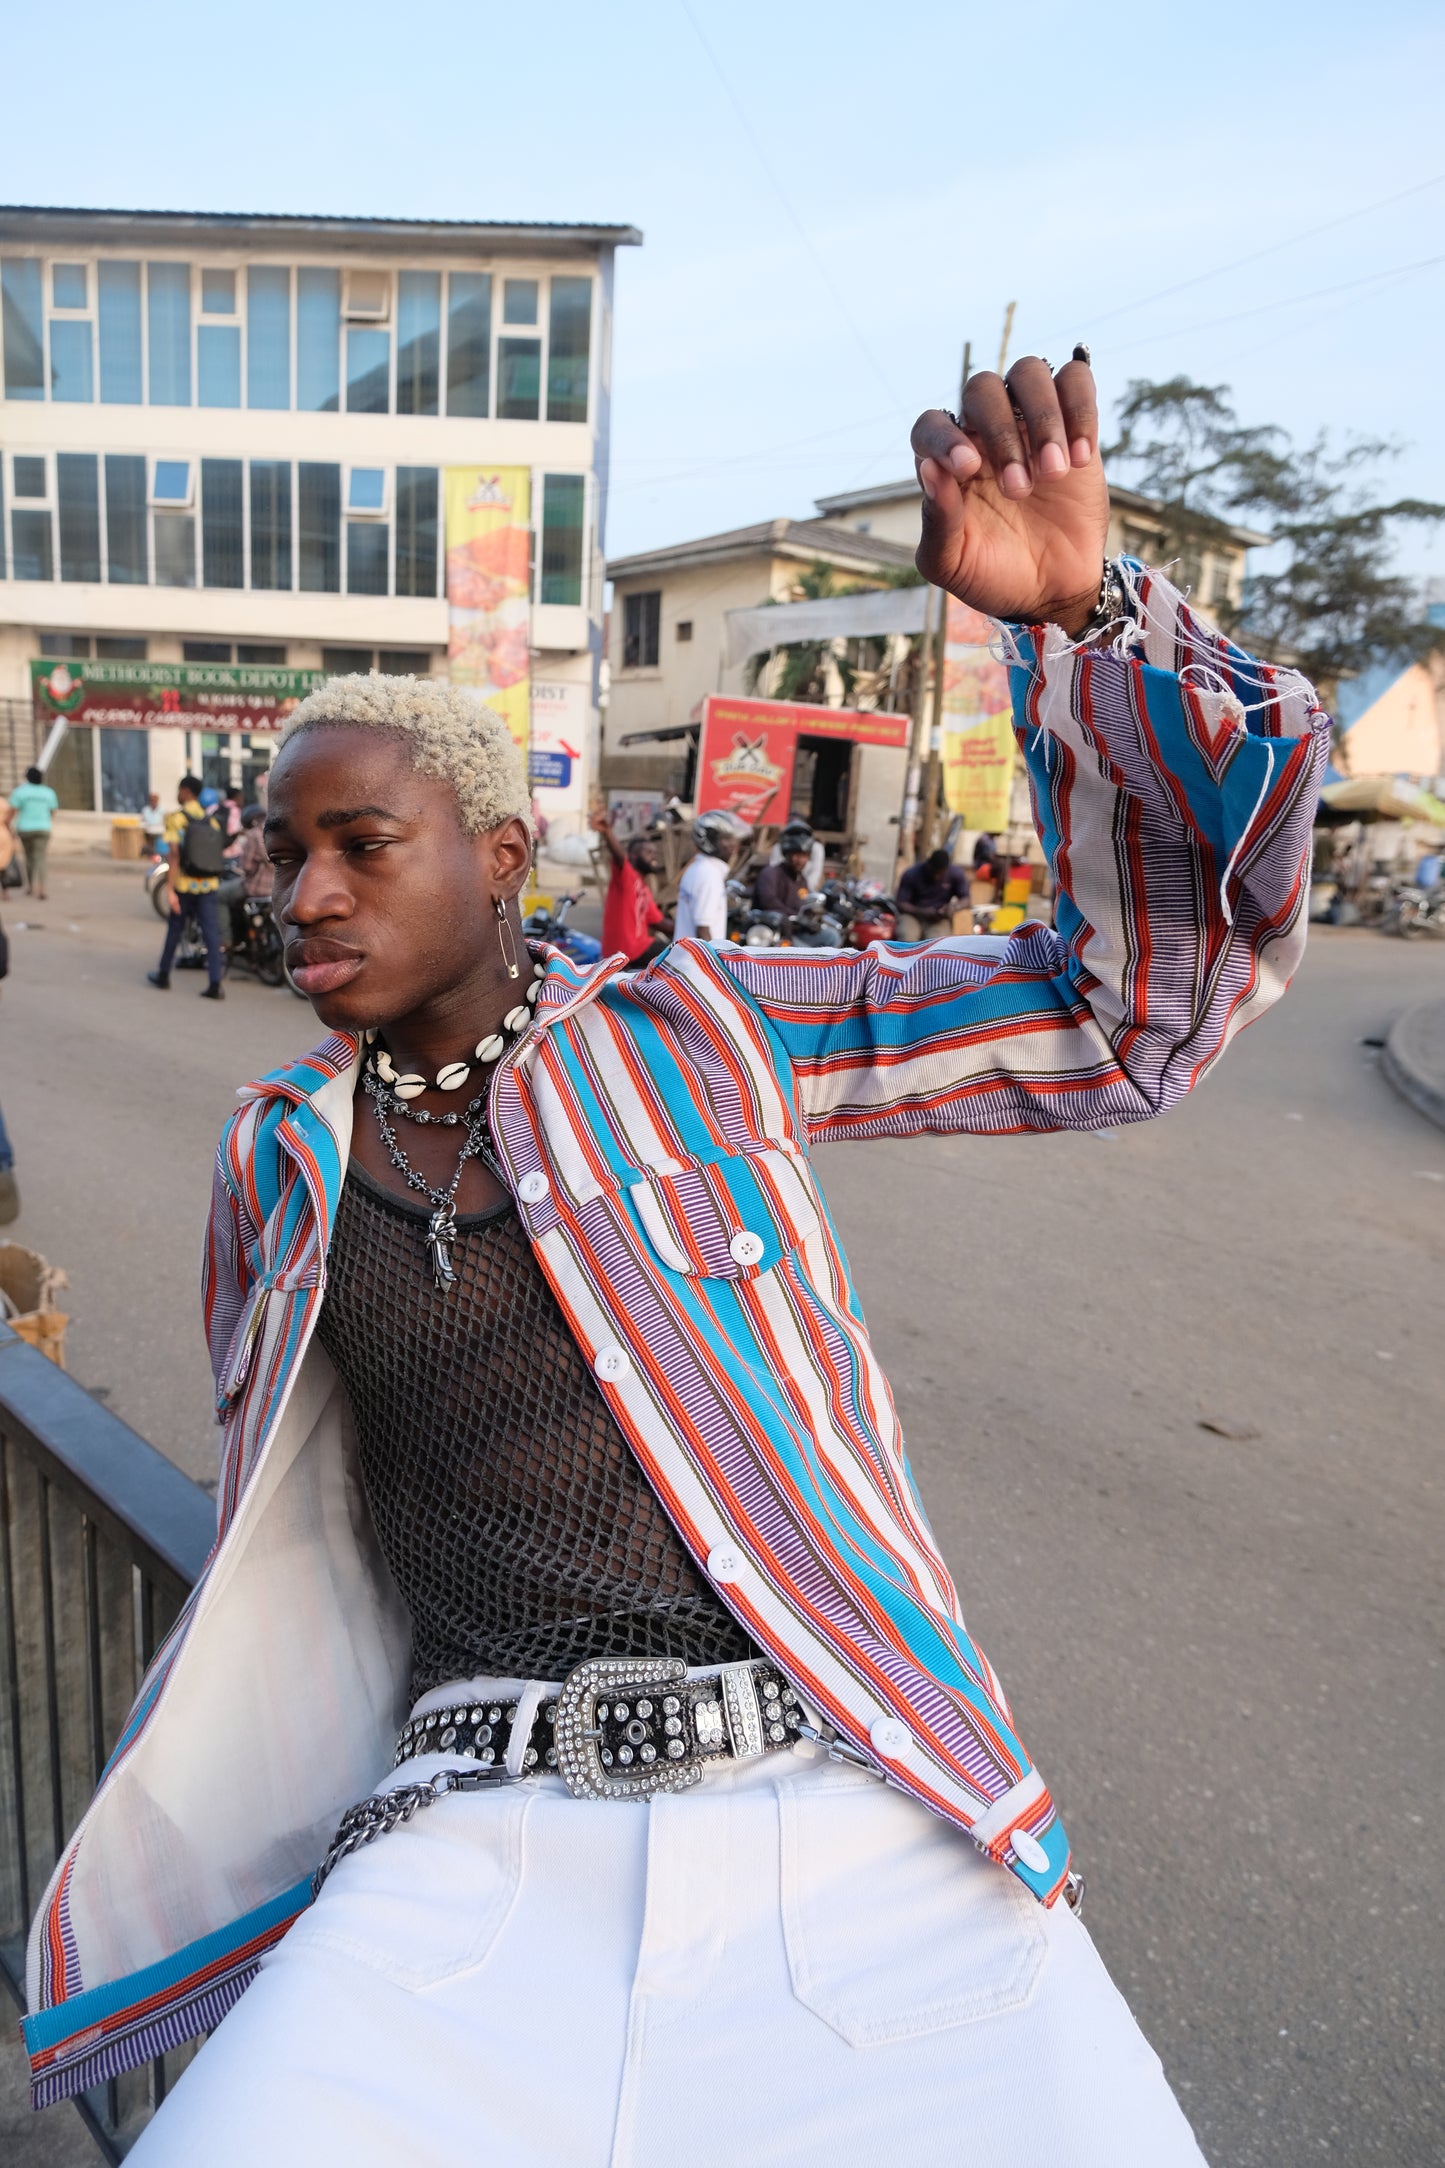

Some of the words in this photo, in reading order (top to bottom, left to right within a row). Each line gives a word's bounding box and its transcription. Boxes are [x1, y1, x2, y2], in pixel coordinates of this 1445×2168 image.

[84, 664, 180, 684] METHODIST
[186, 669, 238, 688] BOOK
[240, 670, 297, 690] DEPOT
